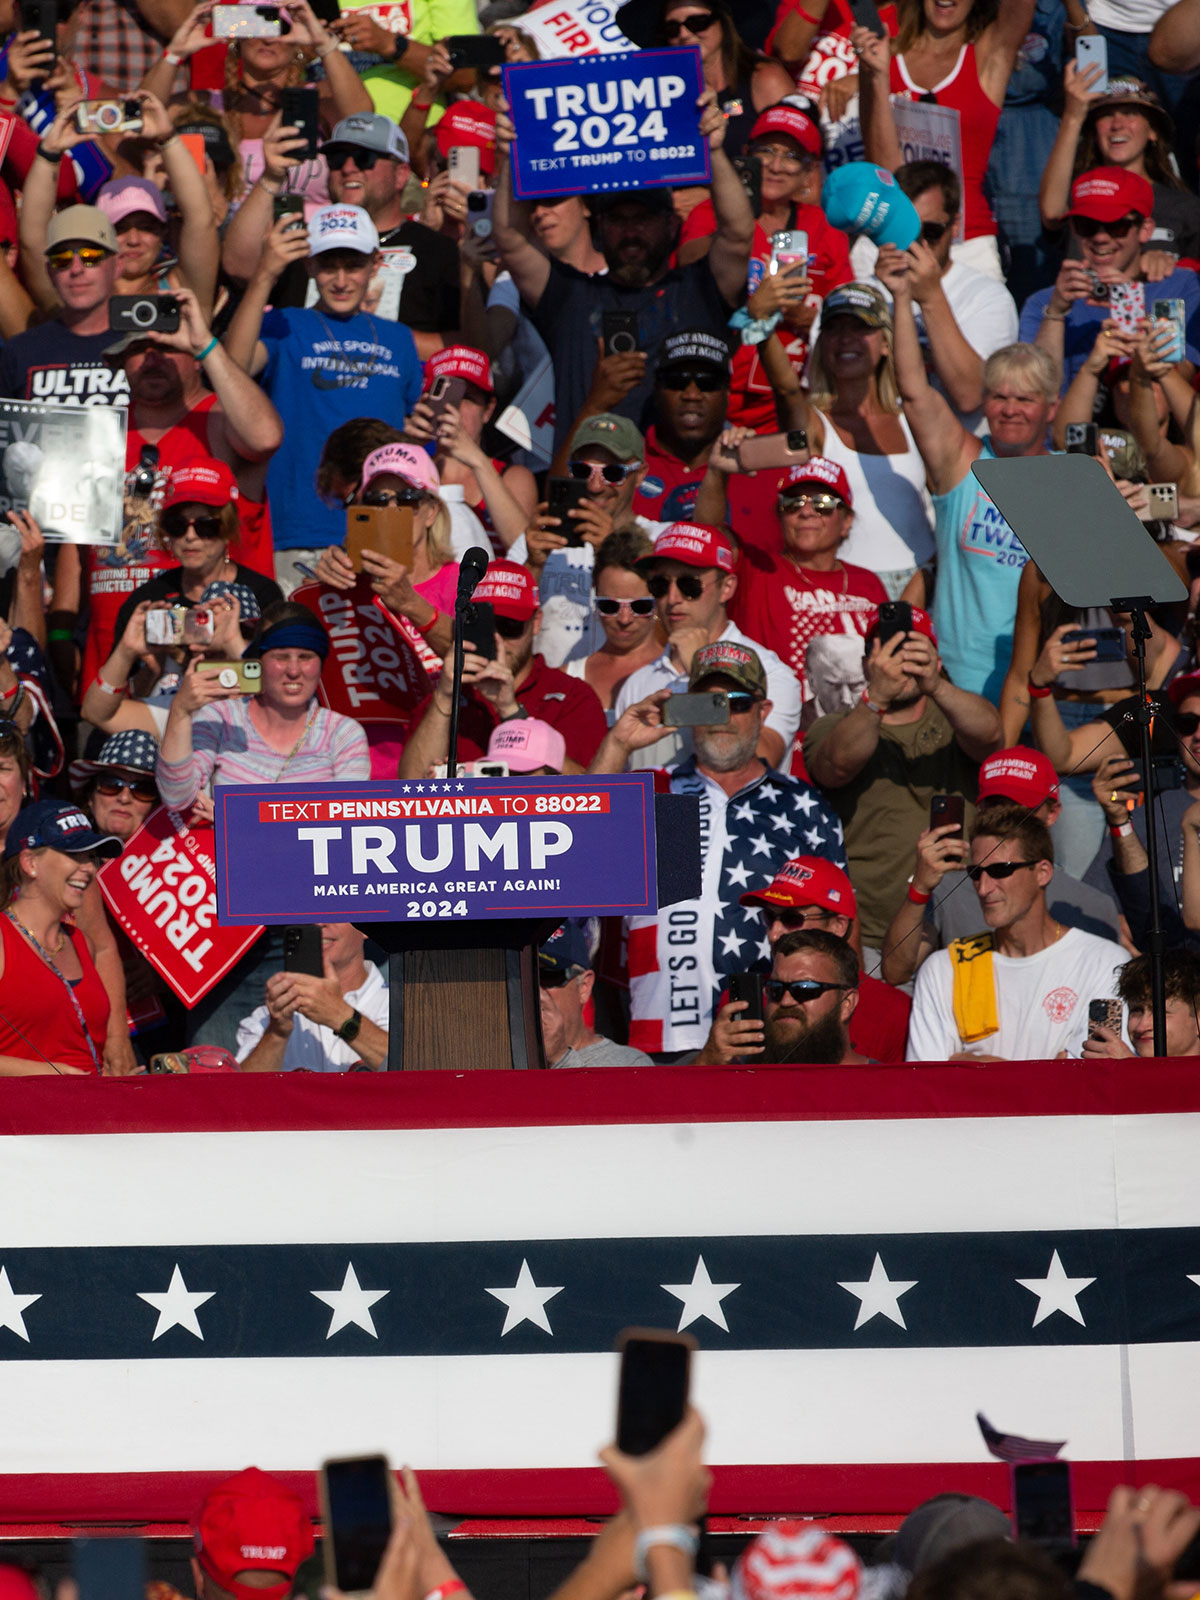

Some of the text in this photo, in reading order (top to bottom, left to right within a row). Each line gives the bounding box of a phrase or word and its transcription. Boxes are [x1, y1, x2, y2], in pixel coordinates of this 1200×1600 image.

[525, 74, 686, 120] TRUMP
[552, 111, 668, 152] 2024
[530, 144, 695, 171] TEXT TRUMP TO 88022
[319, 217, 358, 233] 2024
[312, 339, 392, 361] NIKE SPORTS
[32, 368, 130, 396] ULTRA
[336, 374, 369, 389] 1972
[369, 448, 418, 468] TRUMP
[996, 551, 1028, 568] 202
[487, 570, 527, 587] AMERICA
[495, 585, 522, 600] AGAIN
[318, 590, 370, 707] TRUMP
[355, 603, 406, 692] 2024
[698, 645, 752, 662] TRUMP
[268, 795, 601, 821] TEXT PENNSYLVANIA TO 88022
[297, 820, 574, 875] TRUMP
[152, 837, 218, 926] 2024
[314, 879, 561, 896] MAKE AMERICA GREAT AGAIN!
[119, 853, 213, 973] TRUMP
[406, 899, 468, 919] 2024
[667, 909, 700, 1027] LET'S GO
[240, 1545, 287, 1560] TRUMP
